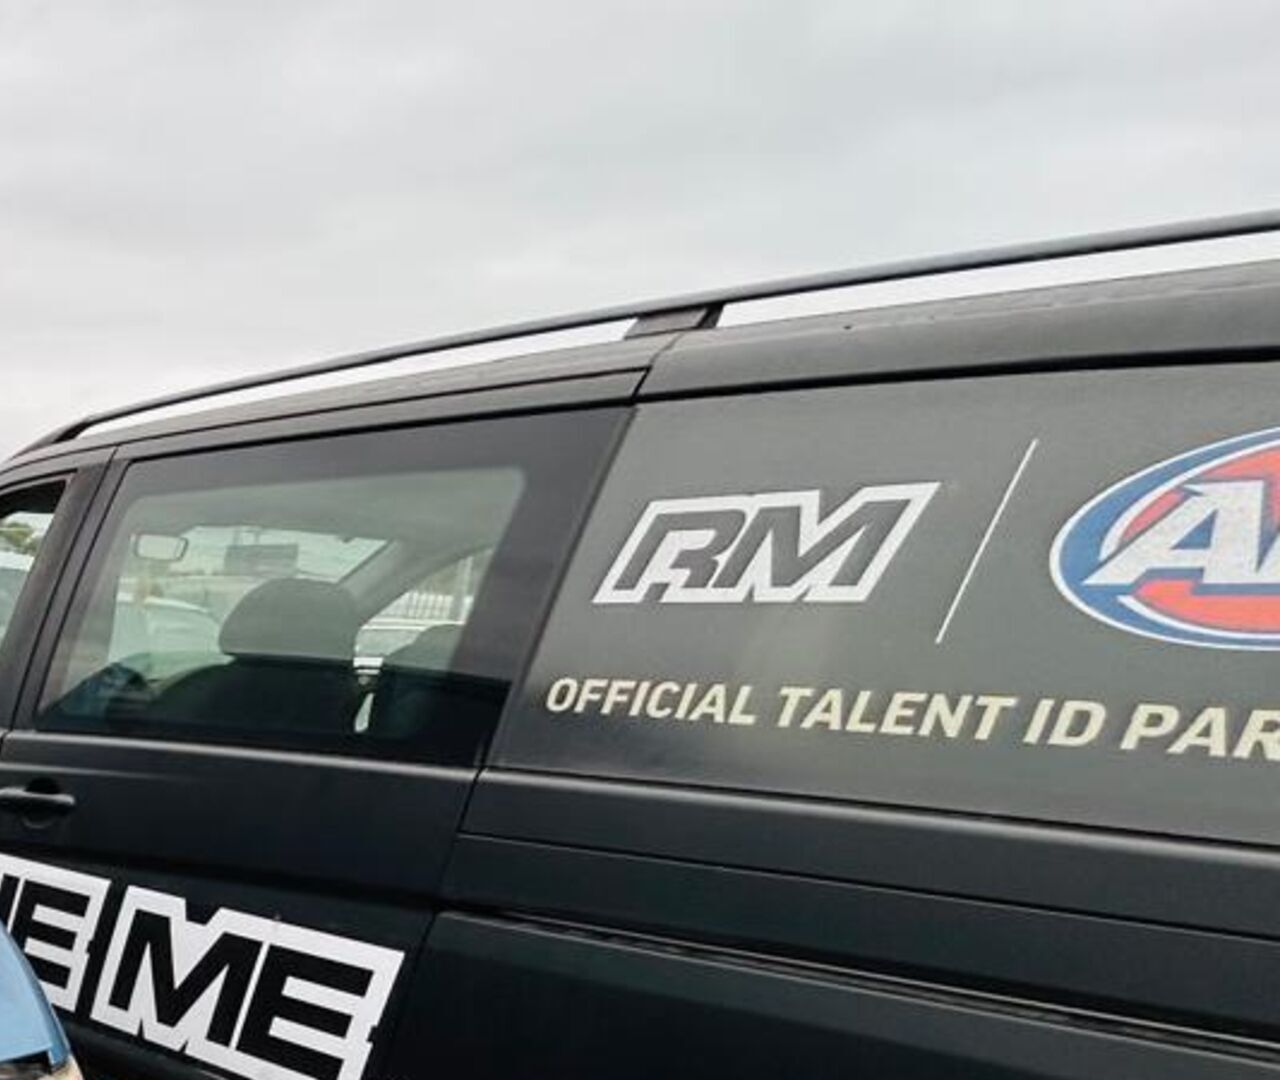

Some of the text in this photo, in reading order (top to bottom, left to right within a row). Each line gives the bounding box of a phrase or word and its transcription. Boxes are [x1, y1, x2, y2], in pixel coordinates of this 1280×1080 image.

[592, 481, 940, 604] RM
[545, 677, 756, 726] OFFICIAL
[775, 686, 1017, 742] TALENT
[1023, 699, 1108, 747] ID
